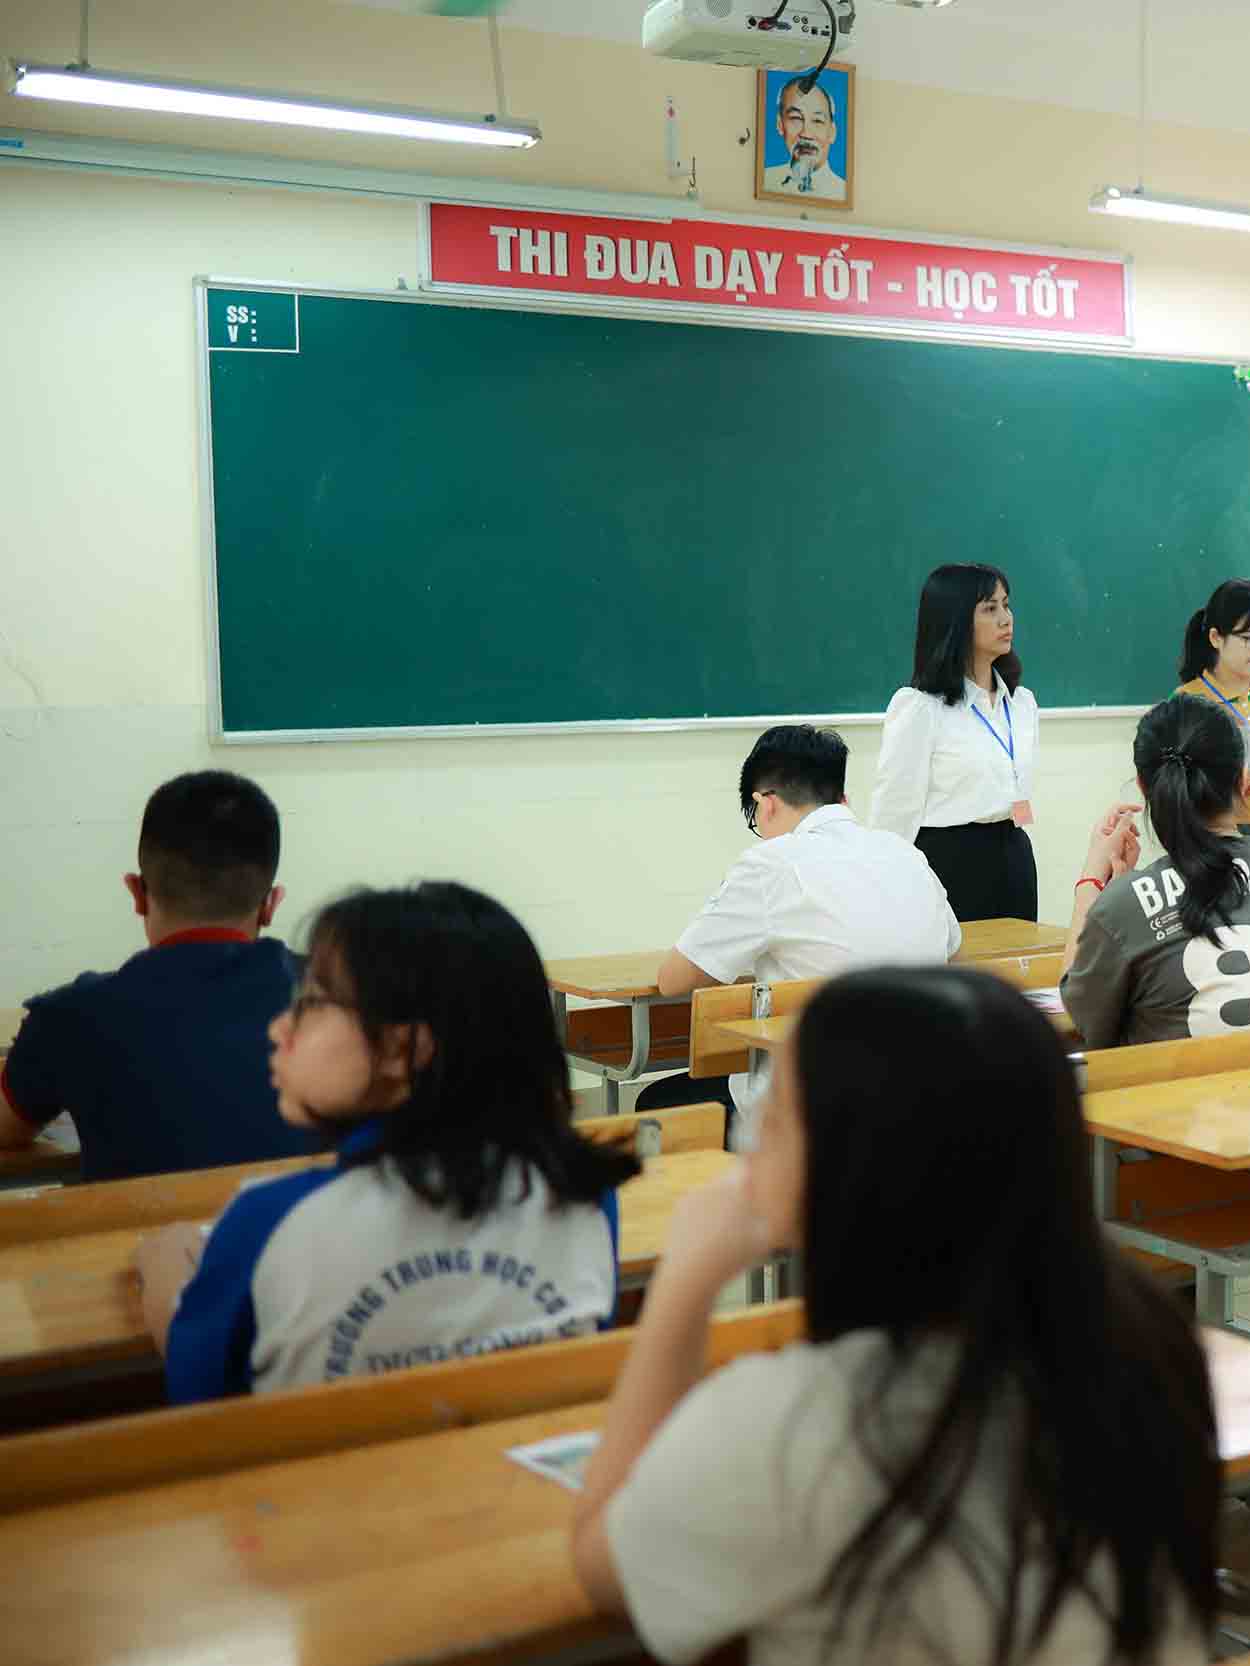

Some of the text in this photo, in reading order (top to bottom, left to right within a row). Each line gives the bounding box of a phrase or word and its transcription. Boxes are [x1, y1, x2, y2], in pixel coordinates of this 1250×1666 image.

[489, 225, 568, 277] THI
[584, 234, 681, 288] ĐUA
[694, 245, 784, 302] DẠY
[796, 243, 873, 304] TỐT
[915, 265, 998, 320] HỌC
[1009, 263, 1080, 320] TỐT
